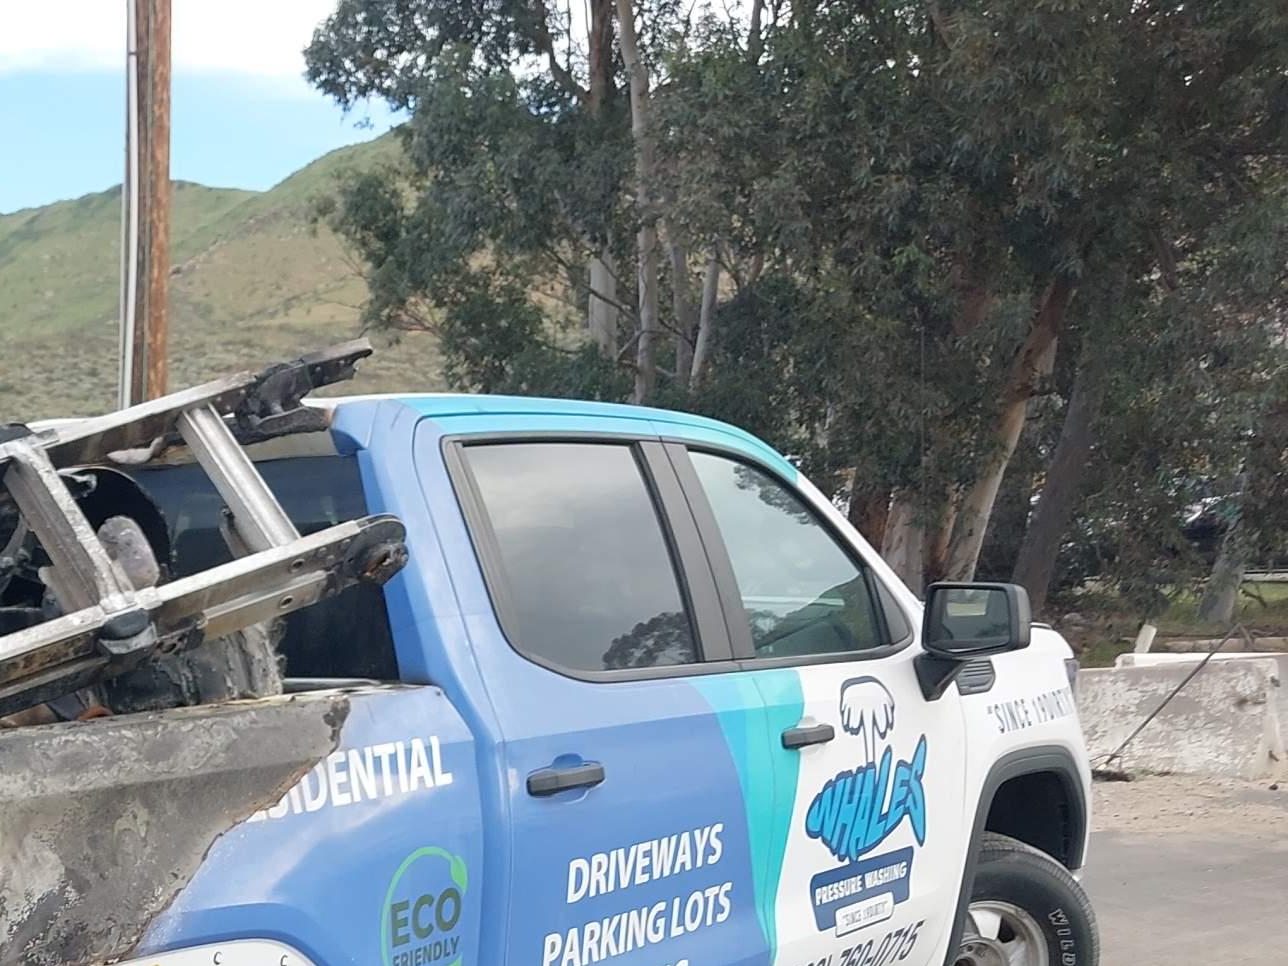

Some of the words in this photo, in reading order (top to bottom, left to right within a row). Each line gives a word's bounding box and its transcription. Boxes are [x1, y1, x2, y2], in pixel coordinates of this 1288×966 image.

[806, 733, 927, 862] WHALES
[566, 822, 724, 904] DRIVEWAYS
[815, 875, 864, 906] PRESSURE
[864, 861, 907, 889] WASHING
[391, 887, 462, 948] ECO
[670, 882, 733, 938] LOTS
